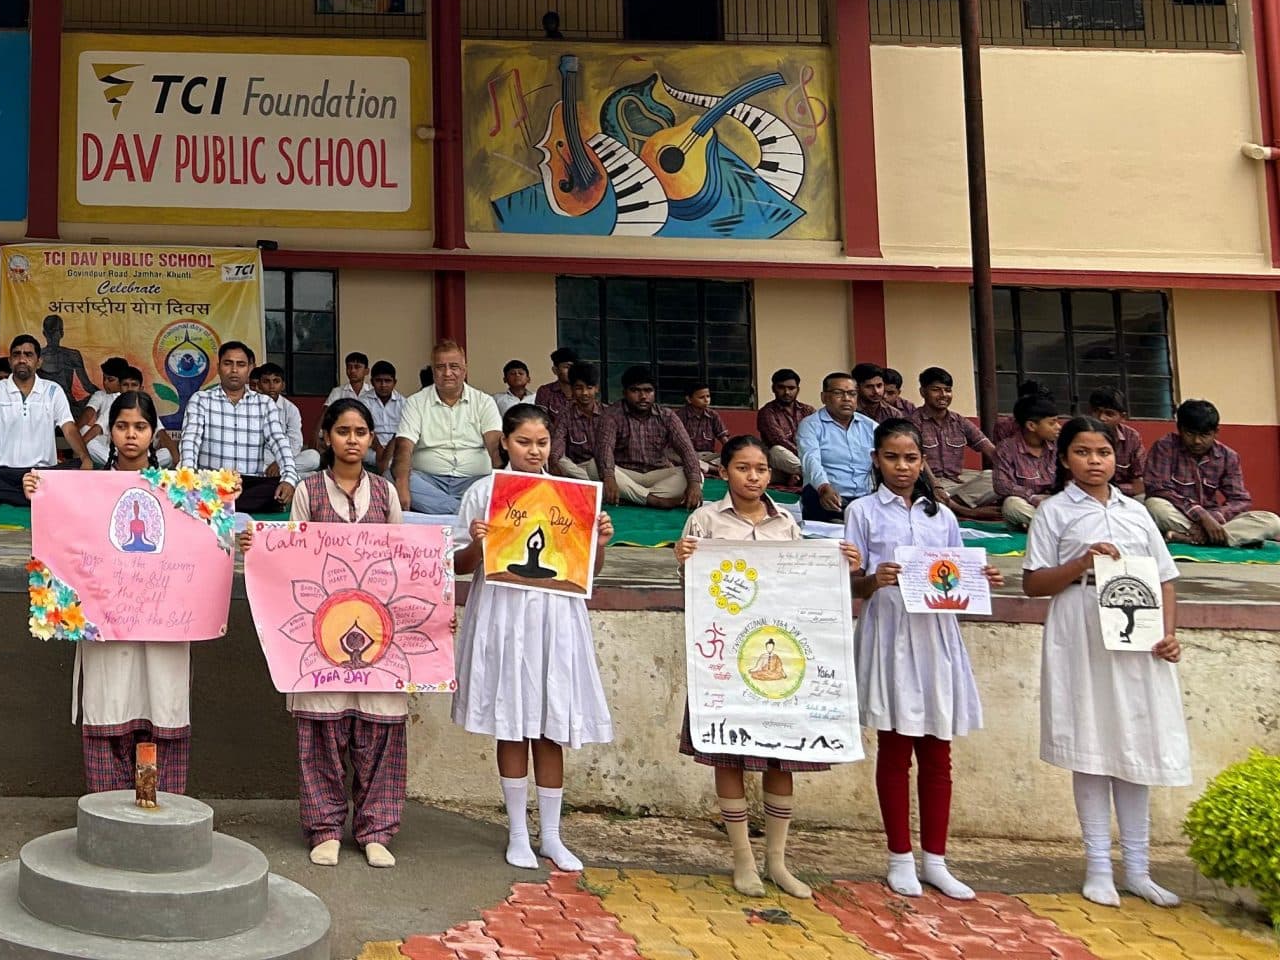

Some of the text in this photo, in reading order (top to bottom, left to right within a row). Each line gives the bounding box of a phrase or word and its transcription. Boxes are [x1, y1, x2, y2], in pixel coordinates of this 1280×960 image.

[151, 74, 398, 119] TCI Foundation
[82, 133, 398, 188] DAV PUBLIC SCHOOL
[44, 251, 215, 268] TCI DAV PUBLIC SCHOOL
[67, 269, 106, 278] Govindpur
[167, 271, 192, 279] Khunti
[235, 264, 254, 276] TCI
[96, 280, 161, 295] Celebrate
[131, 298, 161, 314] योग
[166, 299, 211, 315] दिवस
[505, 500, 528, 526] Yoga
[265, 530, 307, 551] Calm
[355, 532, 391, 548] Mind
[410, 562, 443, 585] Body
[312, 669, 372, 688] YOGA DAY
